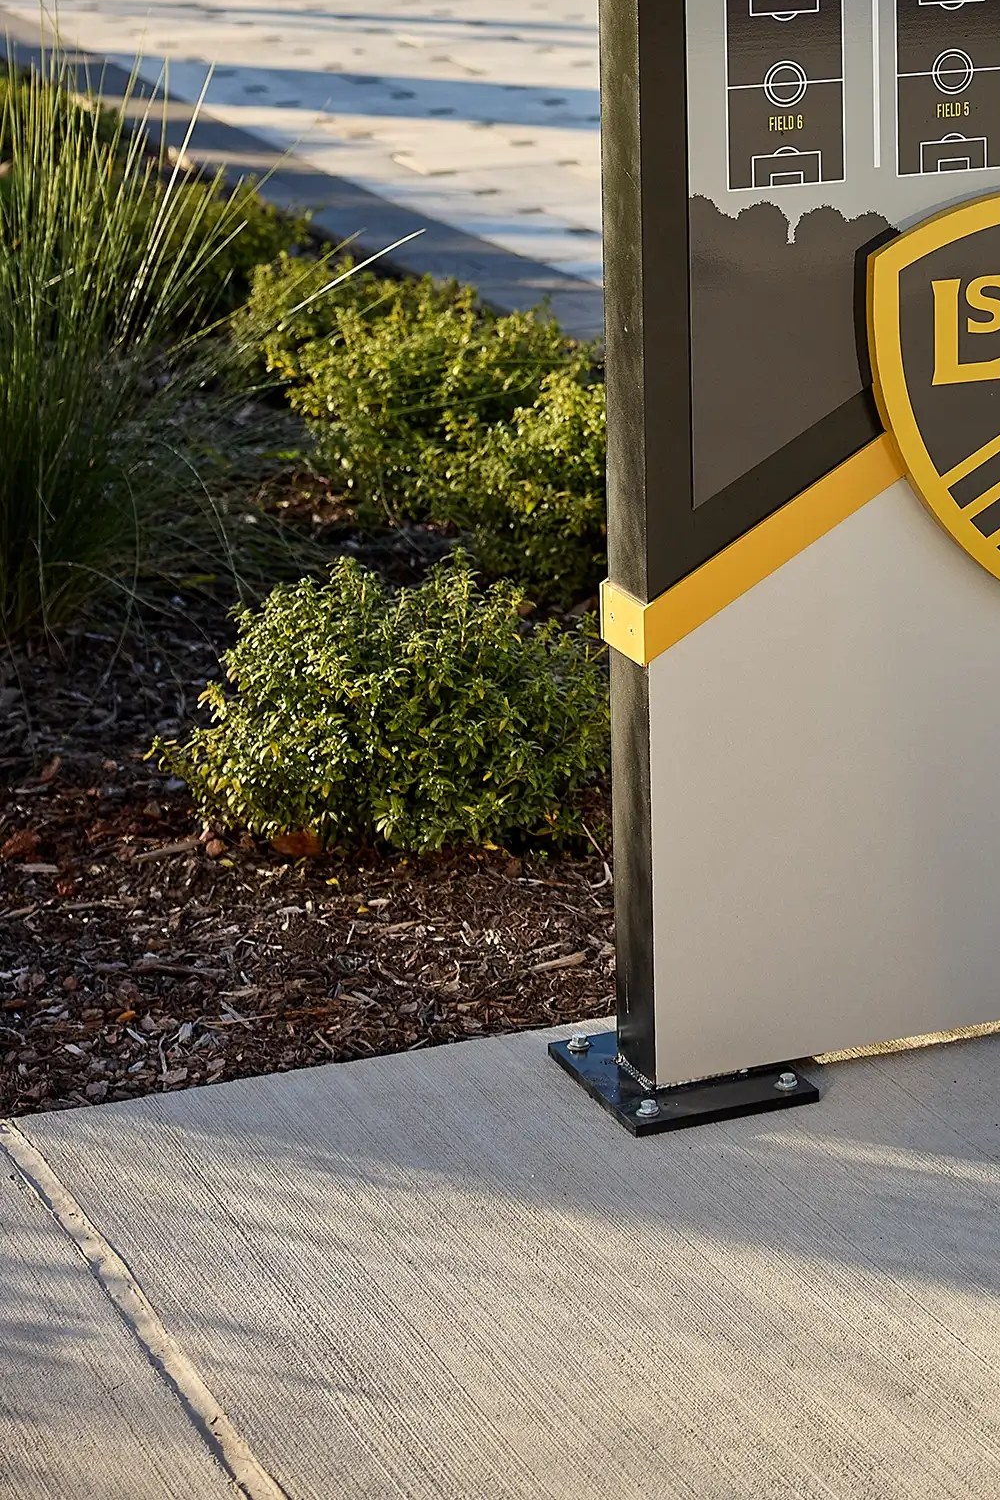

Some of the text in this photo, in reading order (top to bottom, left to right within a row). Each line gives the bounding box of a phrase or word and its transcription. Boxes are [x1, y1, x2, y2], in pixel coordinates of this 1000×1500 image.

[936, 101, 970, 118] FIELD 5
[769, 115, 804, 132] FIELD 6
